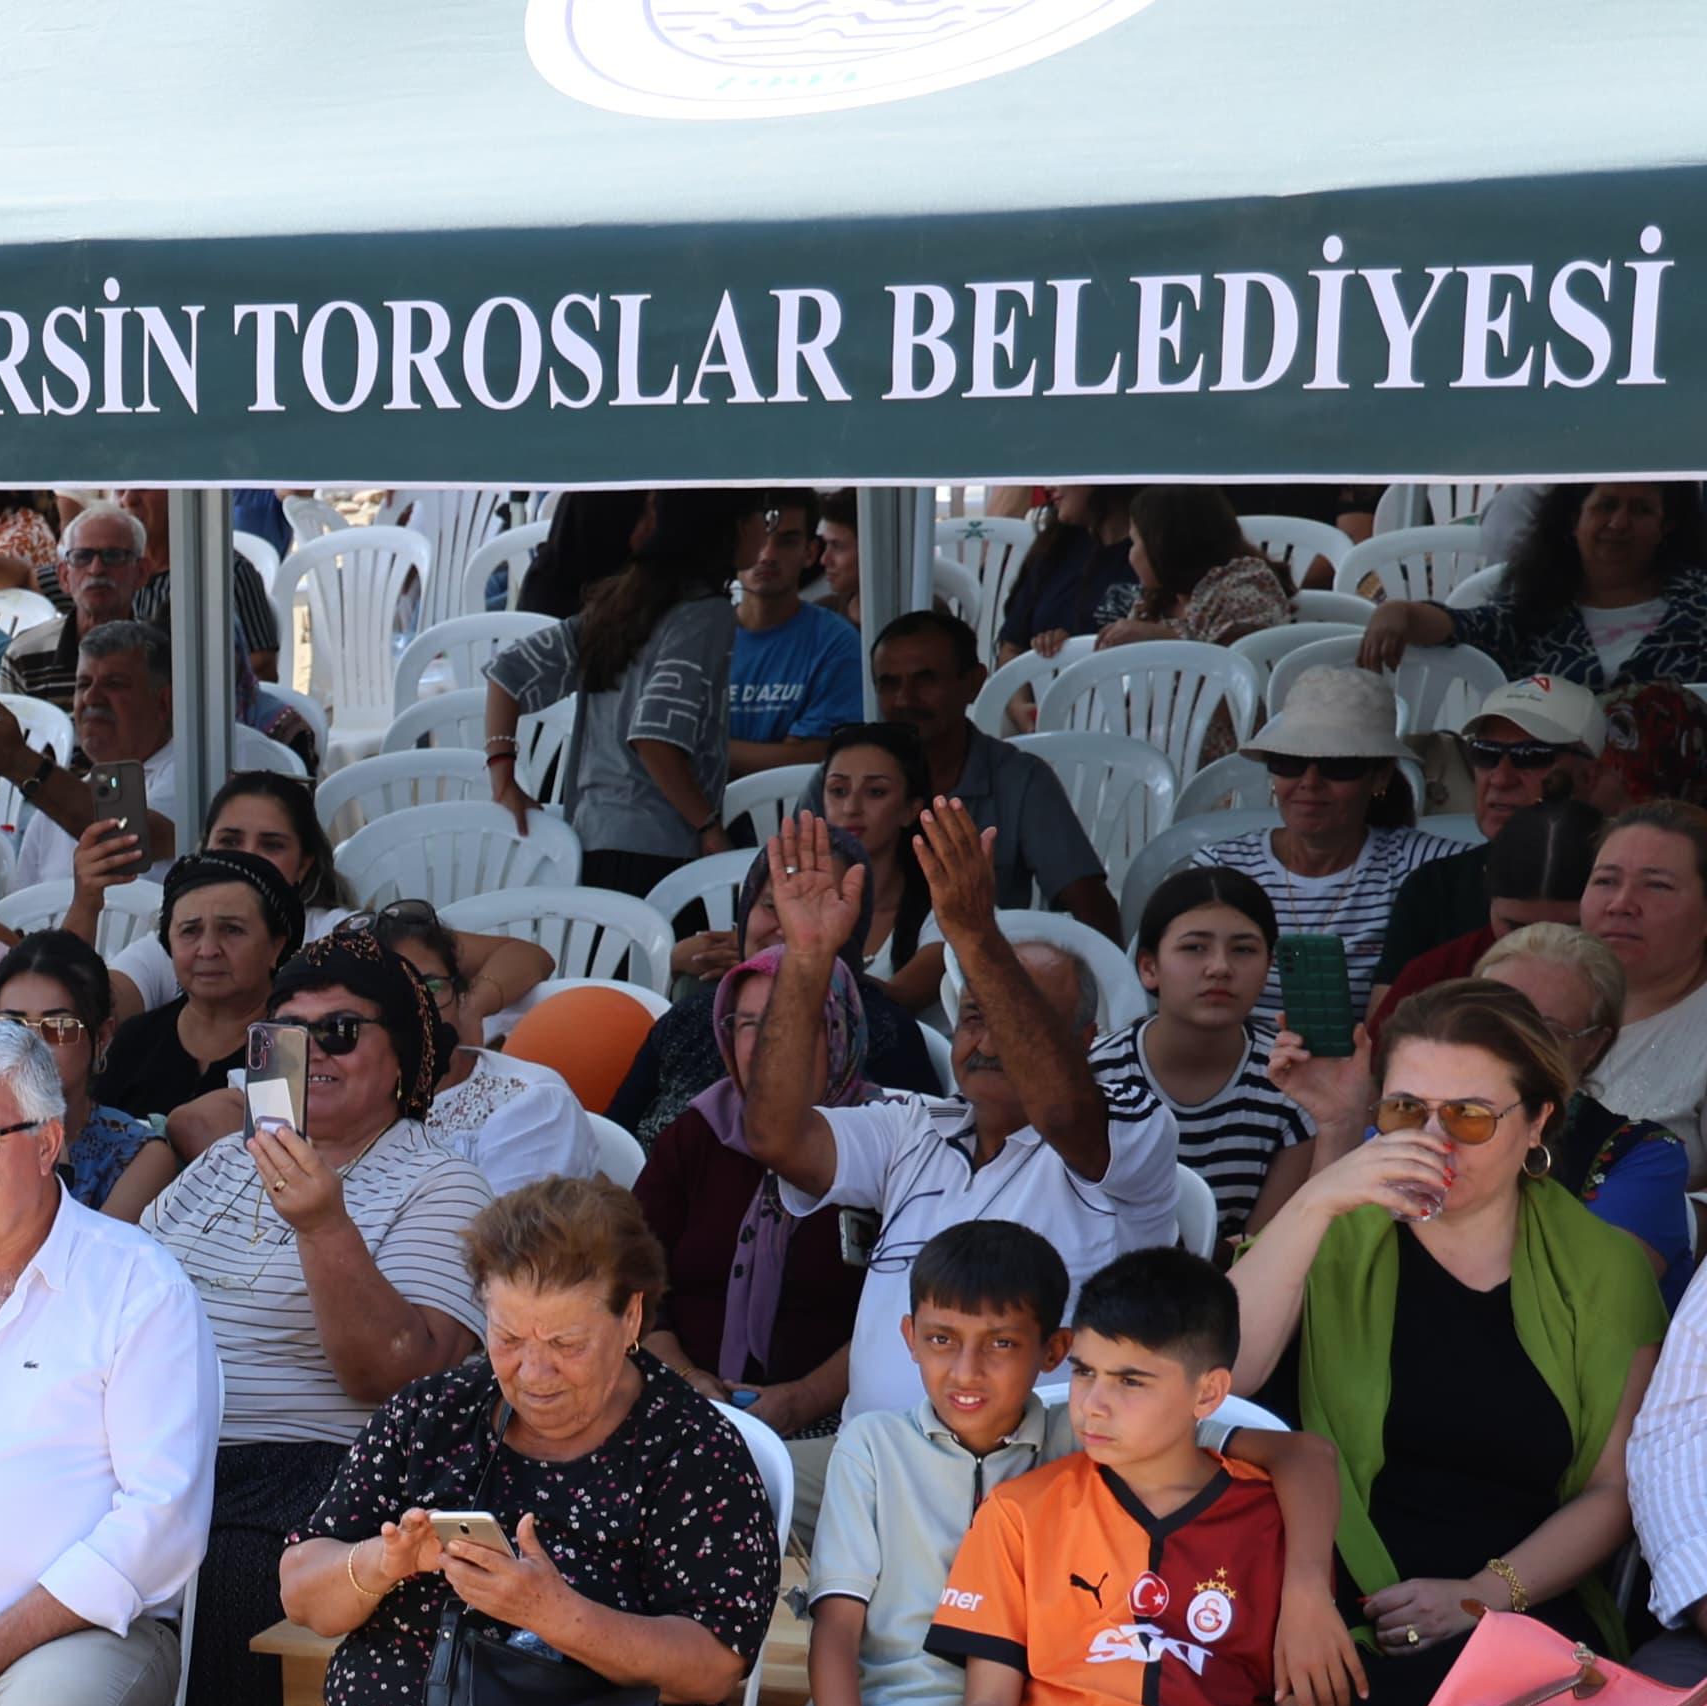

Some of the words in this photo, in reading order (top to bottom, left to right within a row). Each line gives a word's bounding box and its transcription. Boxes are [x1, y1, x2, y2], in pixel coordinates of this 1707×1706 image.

[235, 289, 851, 412] TOROSLAR
[882, 225, 1675, 400] BELEDİYESİ
[940, 1587, 983, 1612] ner
